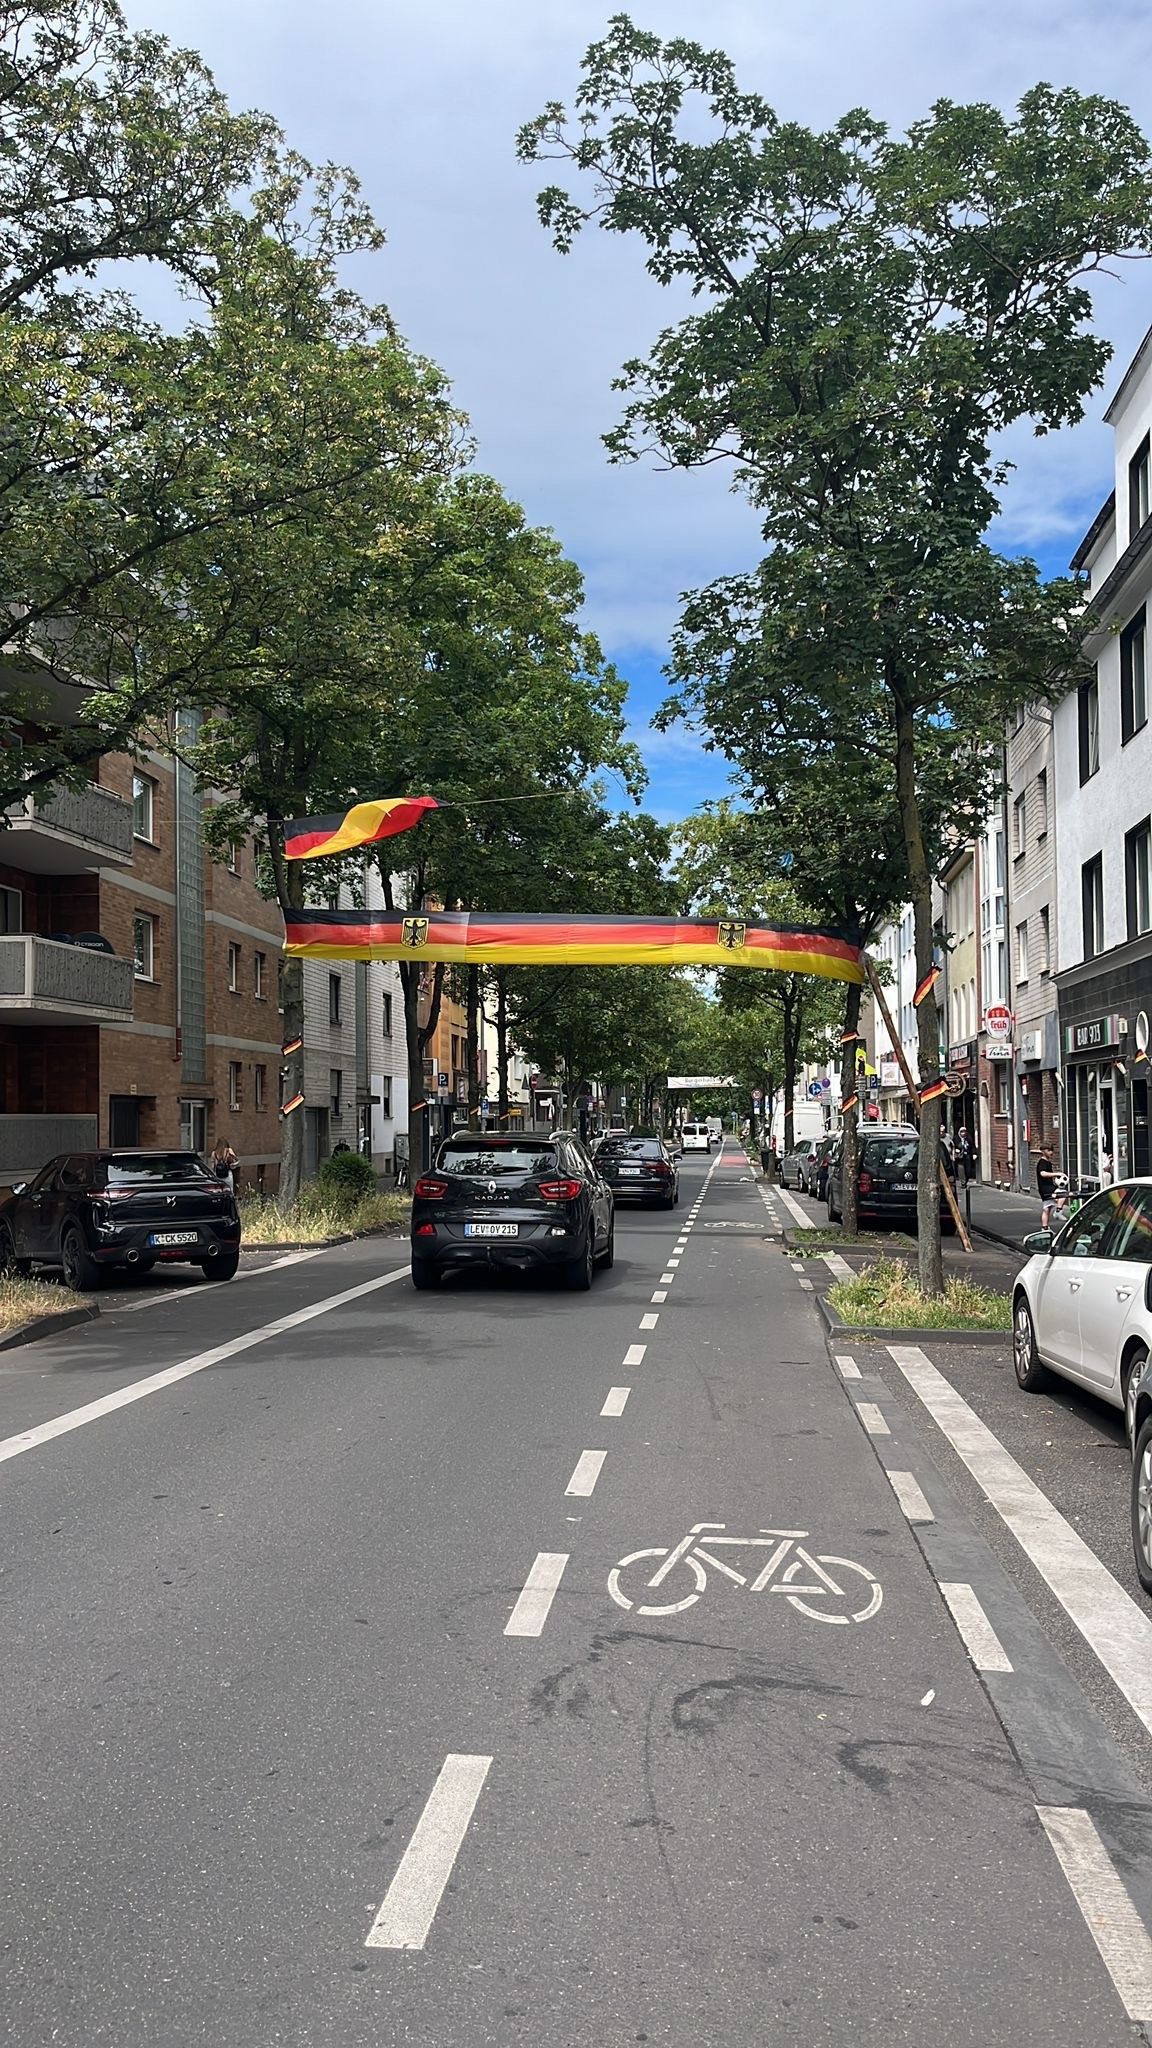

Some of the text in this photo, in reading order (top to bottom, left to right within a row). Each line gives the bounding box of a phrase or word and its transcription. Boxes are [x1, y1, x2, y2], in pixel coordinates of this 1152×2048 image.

[470, 1225, 517, 1234] LEV OY 215
[154, 1232, 197, 1244] K CK 5520
